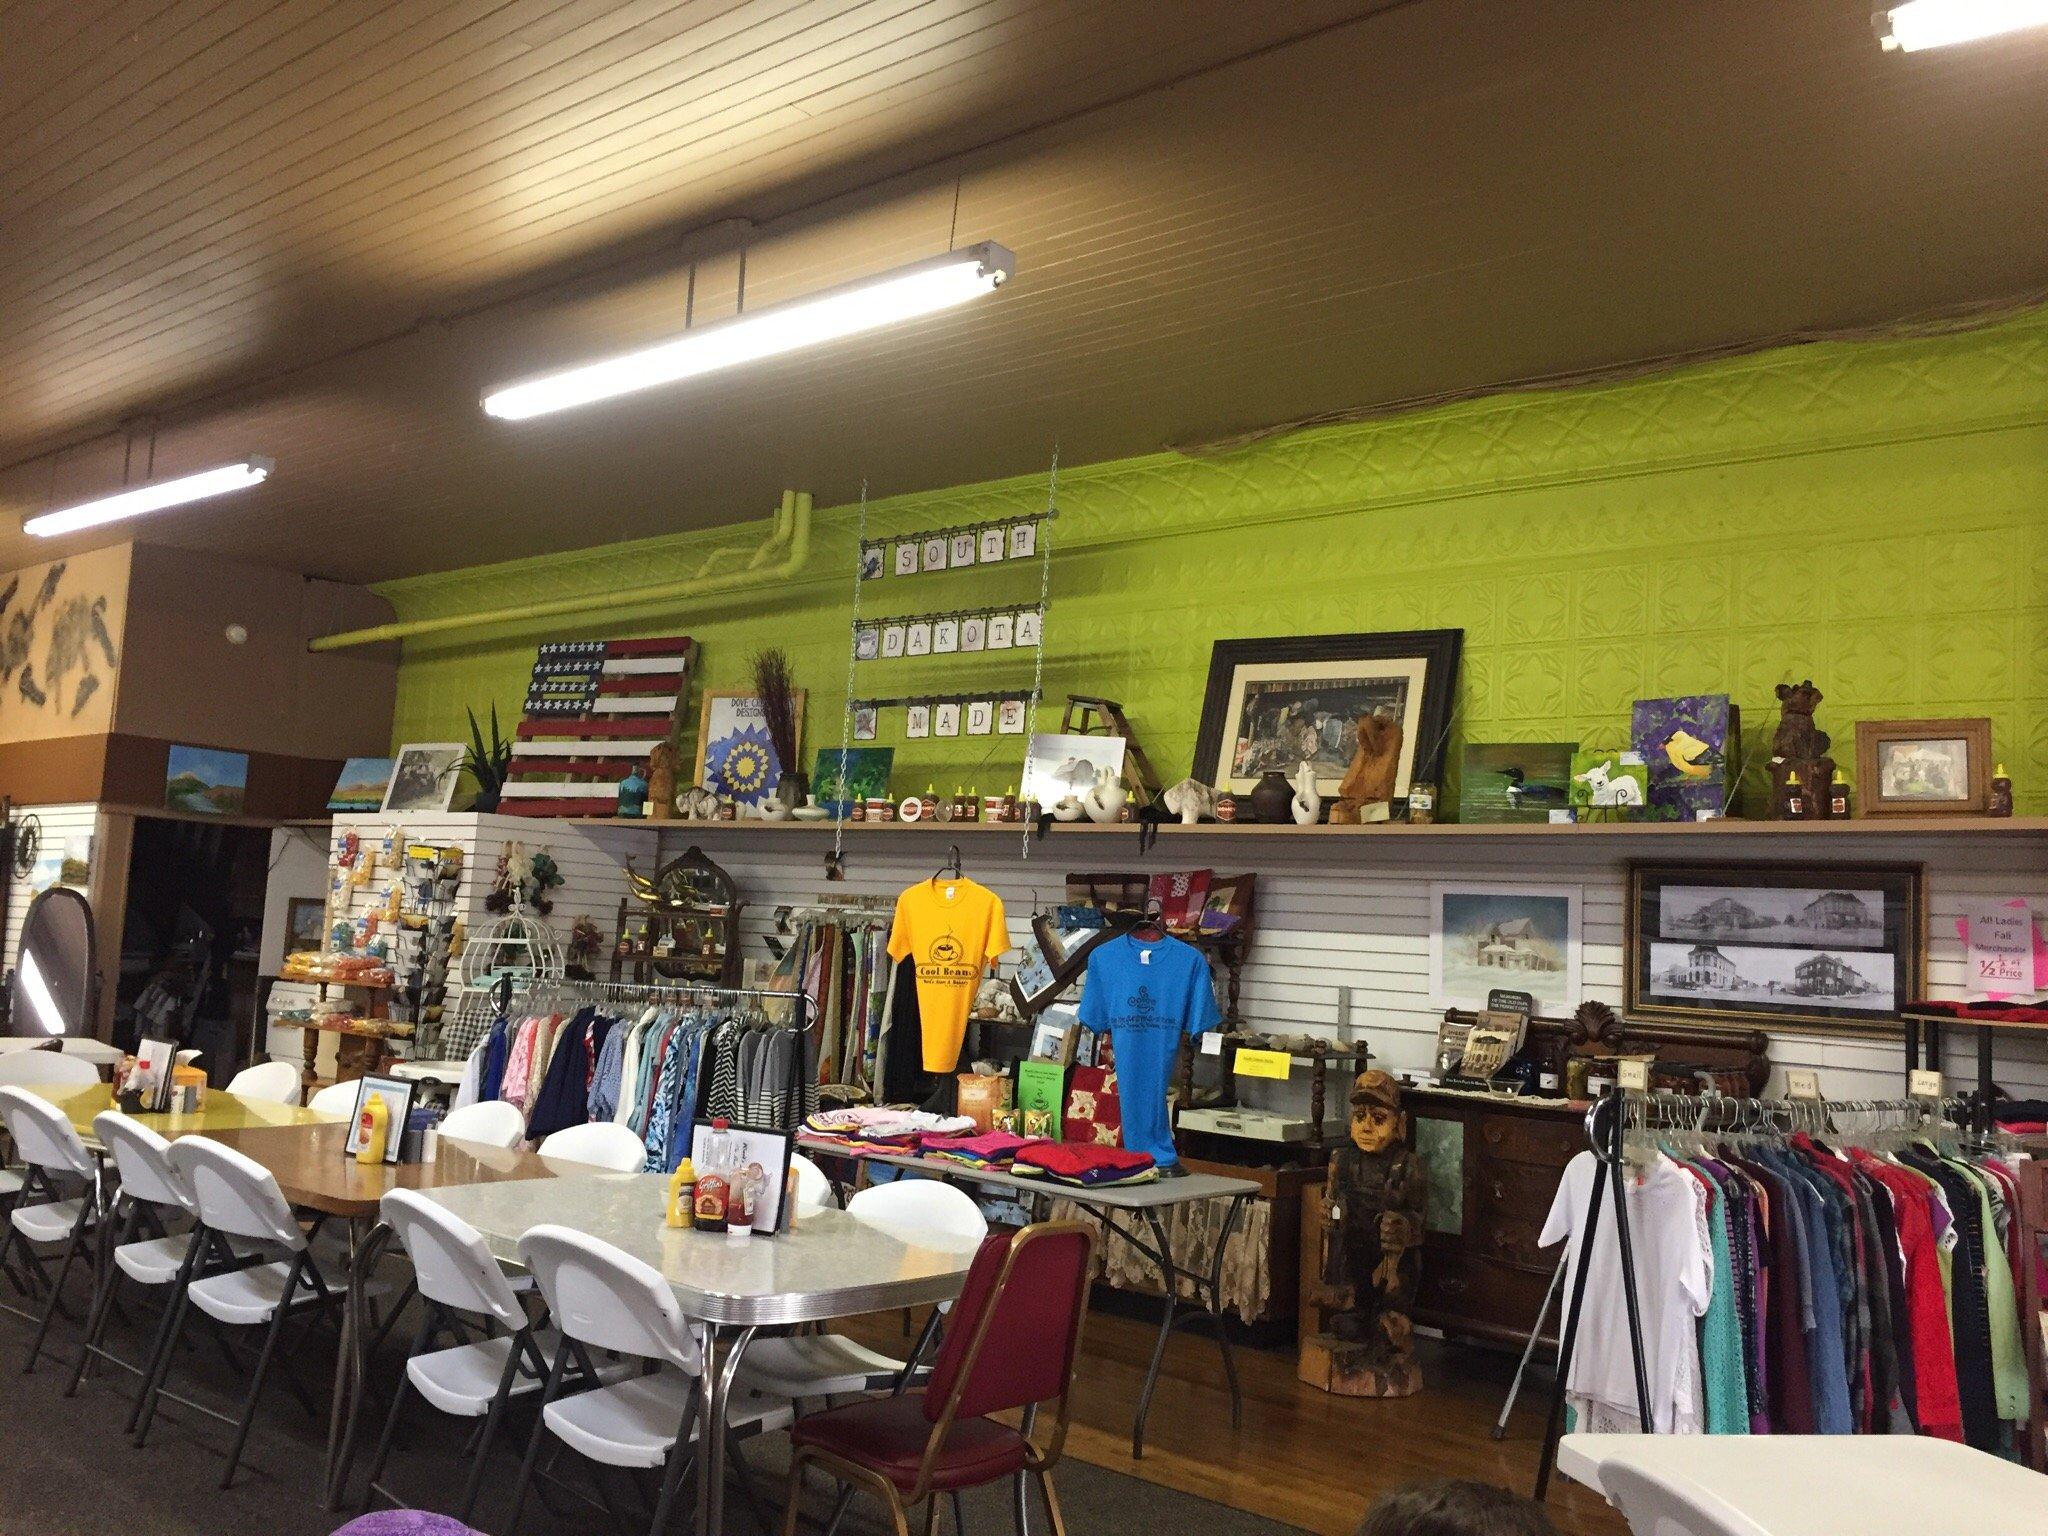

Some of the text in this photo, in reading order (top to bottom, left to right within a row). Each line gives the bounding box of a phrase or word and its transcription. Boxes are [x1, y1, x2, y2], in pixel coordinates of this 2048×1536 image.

[902, 531, 1026, 567] SOUTH
[887, 621, 1032, 650] DAKOTA
[912, 708, 1016, 730] MADE
[1980, 916, 2022, 926] All Ladies
[1994, 931, 2011, 940] Fall
[1975, 943, 2026, 953] Merchandise
[920, 967, 972, 976] Cool Beans
[1999, 968, 2022, 977] Price
[1917, 1079, 1937, 1090] Large
